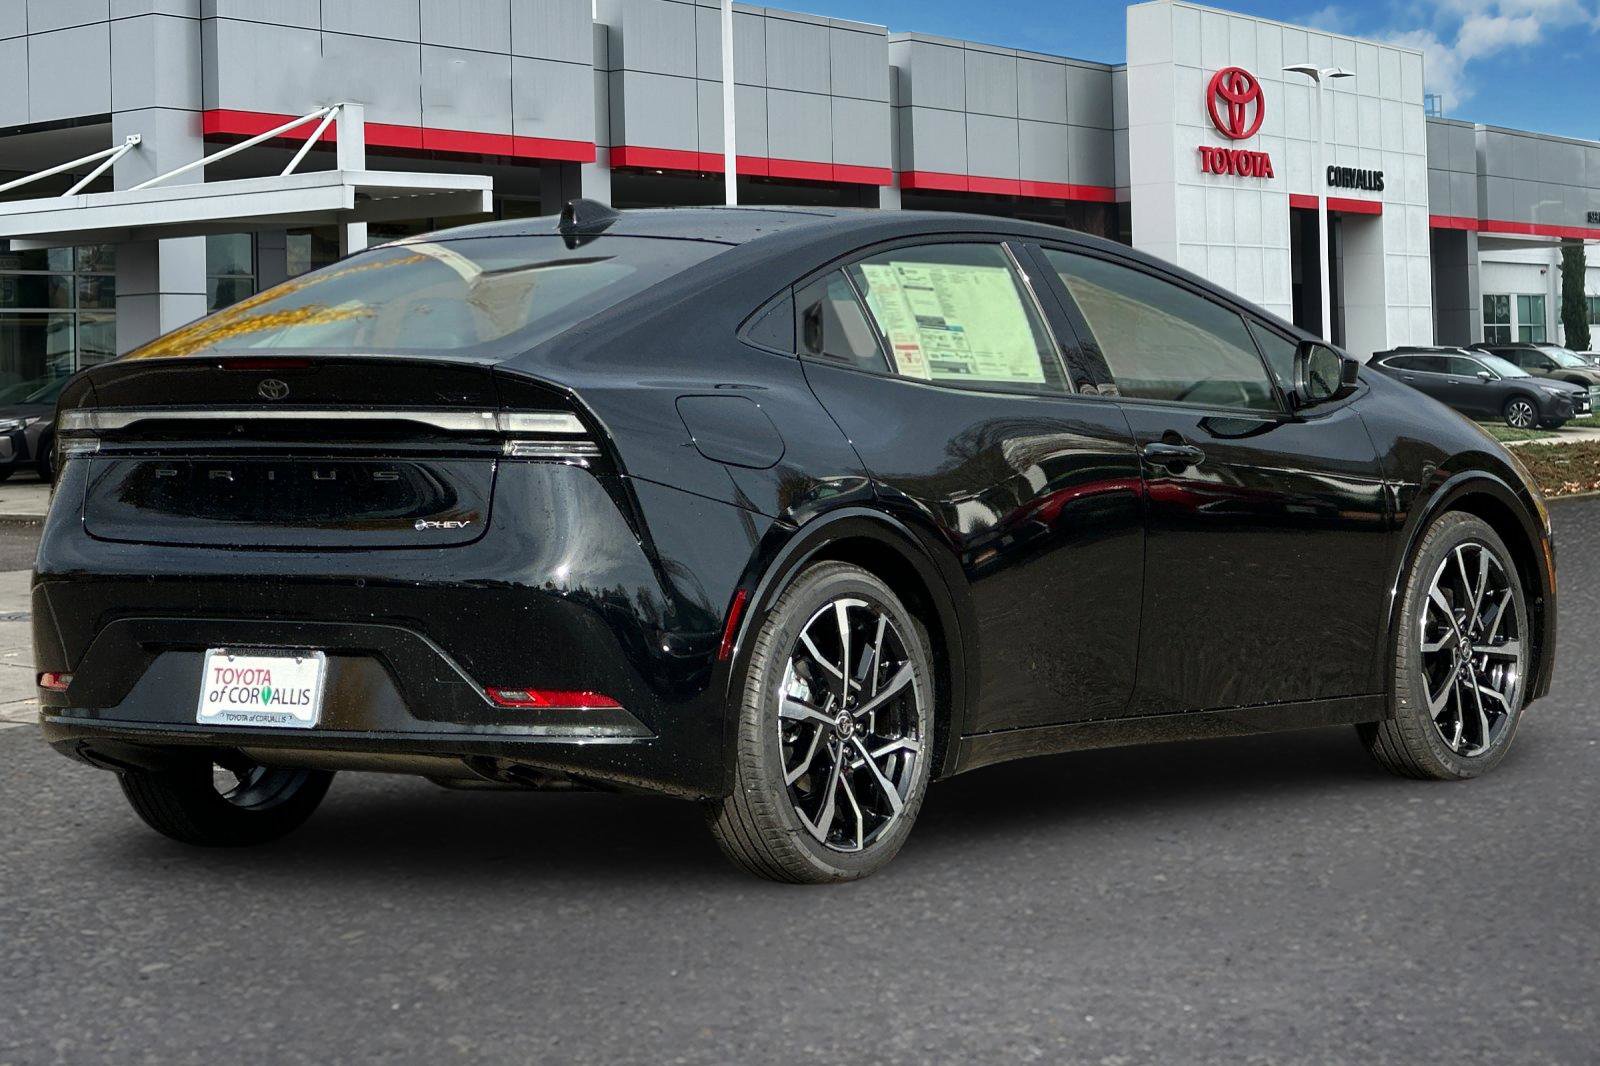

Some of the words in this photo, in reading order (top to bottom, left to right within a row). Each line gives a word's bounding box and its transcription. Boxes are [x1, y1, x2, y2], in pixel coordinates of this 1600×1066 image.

[1198, 146, 1274, 178] TOYOTA
[1327, 165, 1384, 191] CORVALLIS
[155, 470, 398, 481] PRIUS
[425, 519, 470, 529] PHEV
[214, 668, 271, 686] TOYOTA
[209, 686, 228, 702] of
[225, 713, 247, 721] TOYOTA
[249, 714, 256, 722] of
